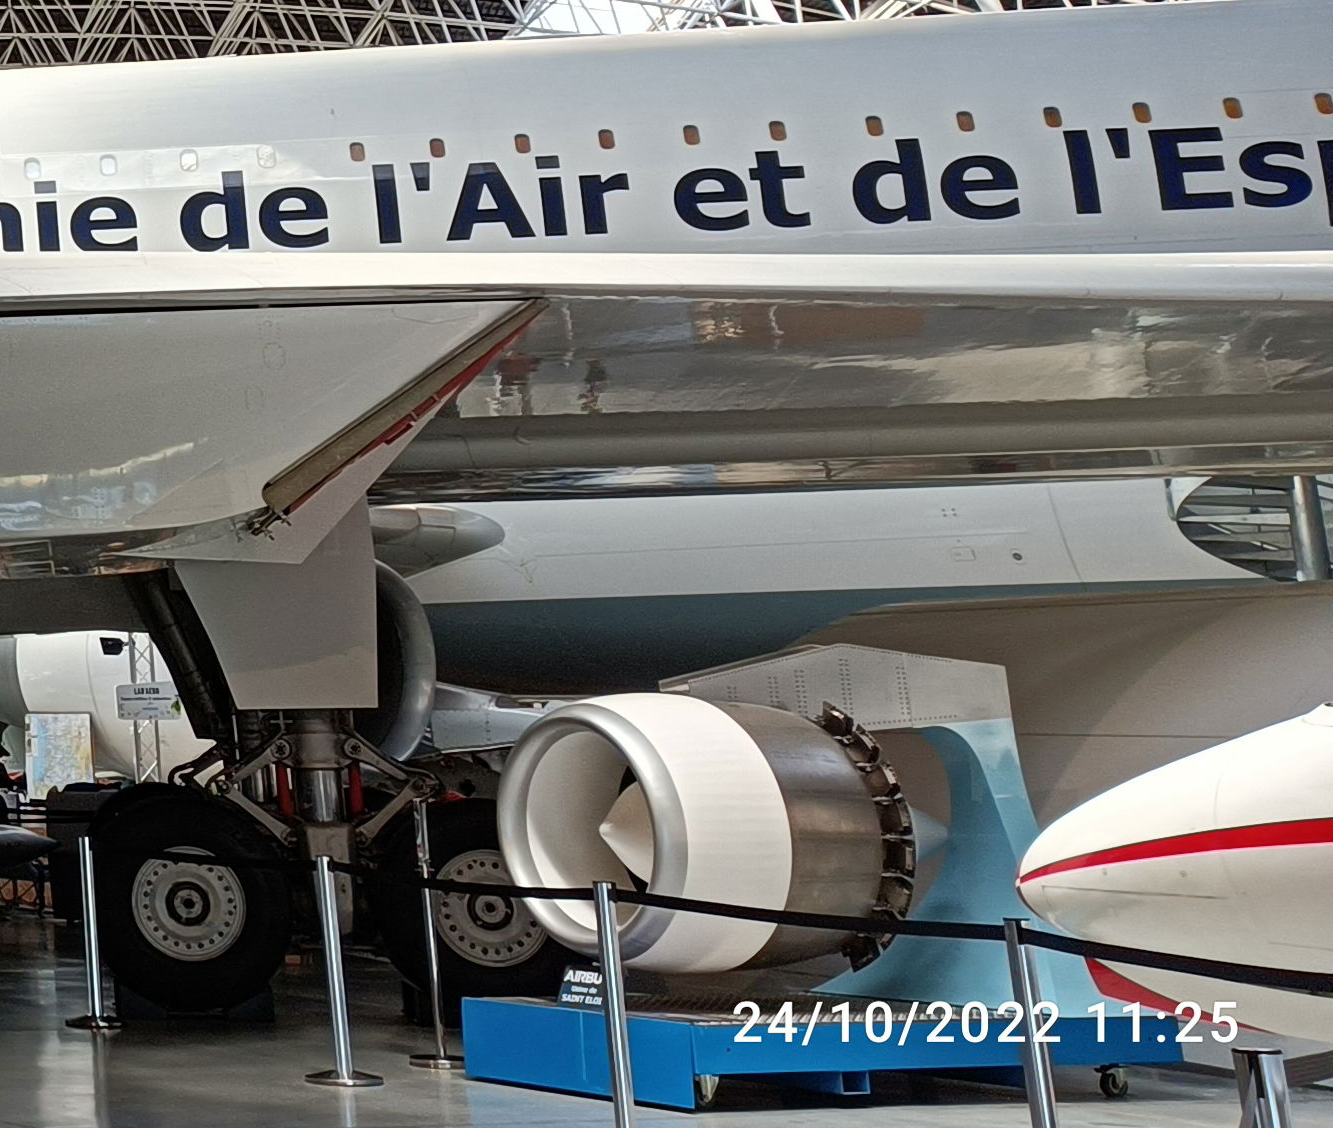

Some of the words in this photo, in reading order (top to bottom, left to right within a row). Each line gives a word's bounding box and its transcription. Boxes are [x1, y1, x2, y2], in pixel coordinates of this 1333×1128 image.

[179, 170, 329, 253] de
[372, 154, 629, 245] l'Air
[673, 150, 811, 232] et
[851, 137, 1021, 222] de
[1062, 125, 1333, 228] l'Es
[563, 969, 603, 985] AIRBU
